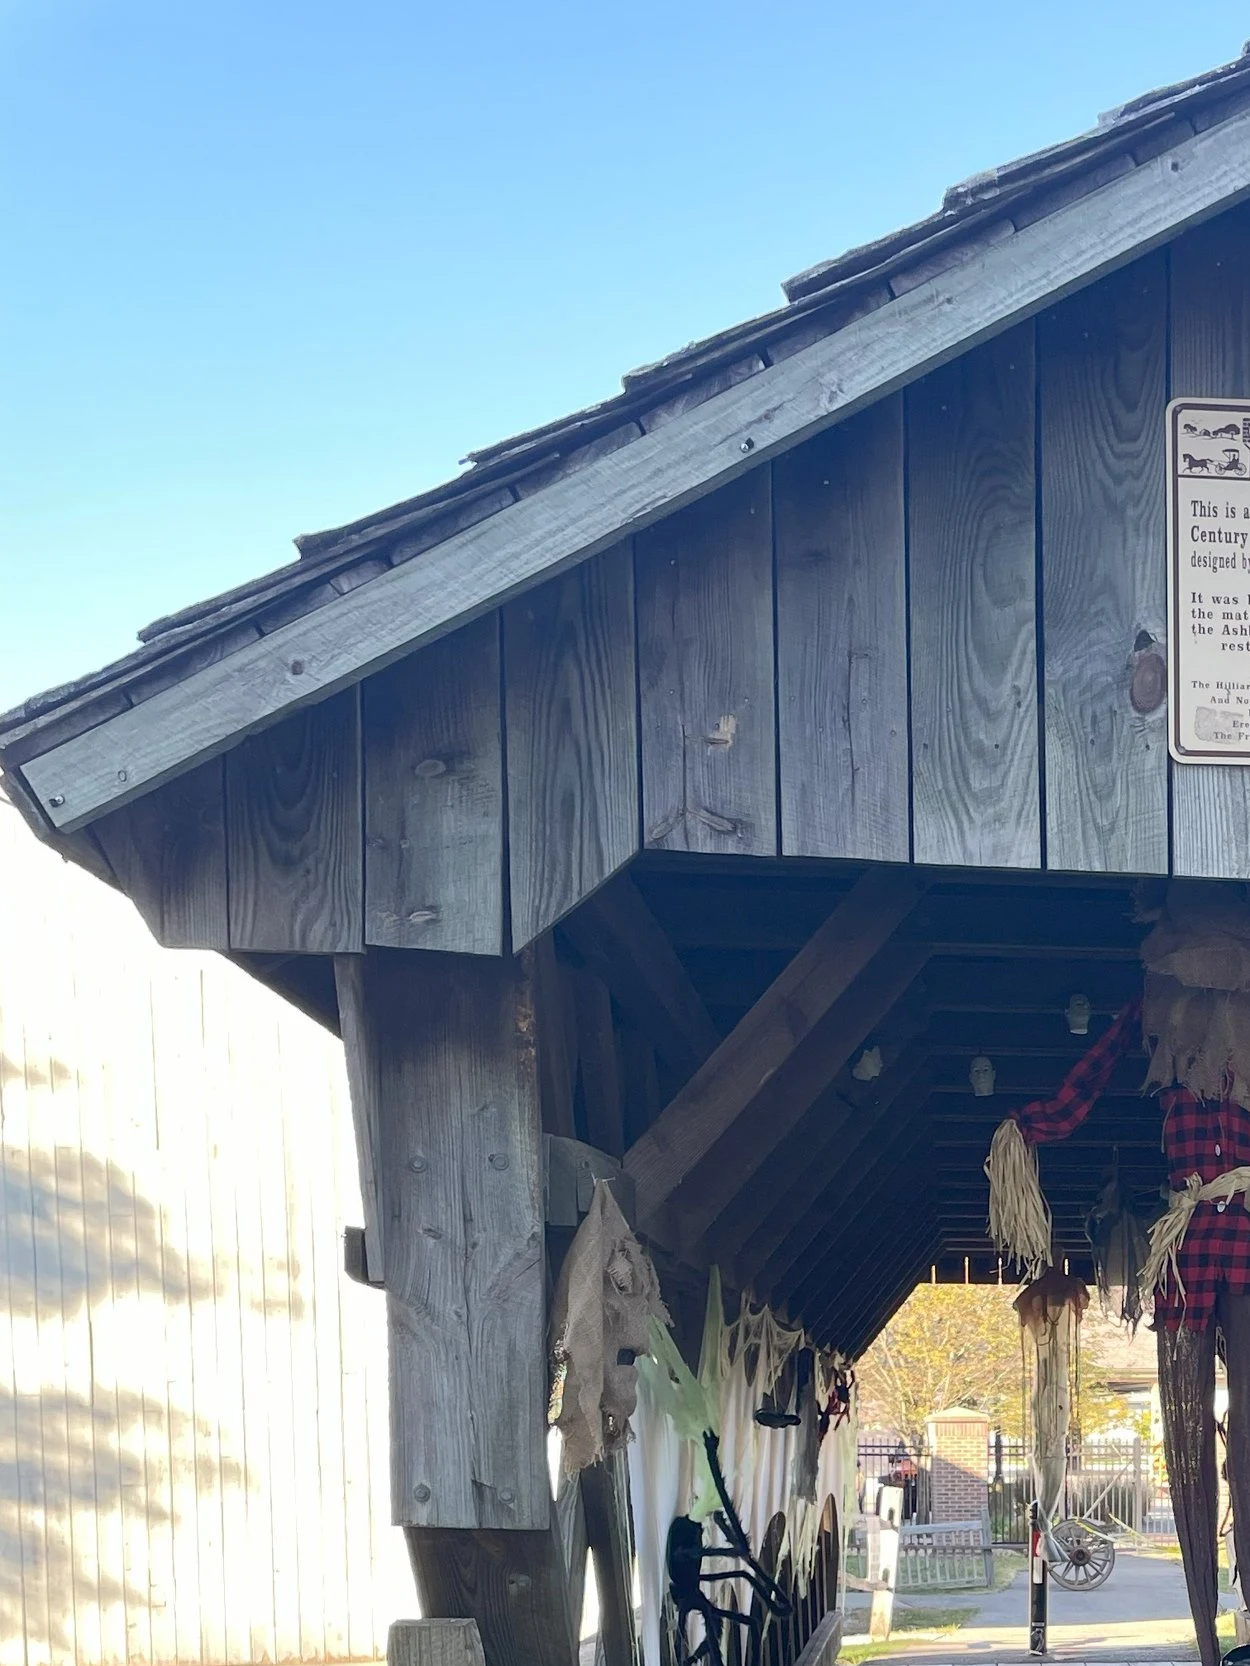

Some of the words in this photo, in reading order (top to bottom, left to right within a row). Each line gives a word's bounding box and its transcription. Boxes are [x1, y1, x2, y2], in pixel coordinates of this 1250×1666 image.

[1191, 500, 1217, 517] This
[1226, 502, 1235, 518] is
[1244, 507, 1250, 519] a
[1191, 525, 1248, 548] Century
[1191, 551, 1236, 573] designed
[1192, 592, 1202, 603] It
[1212, 596, 1238, 604] was
[1192, 608, 1213, 619] the
[1192, 624, 1213, 635] the
[1210, 696, 1230, 704] And
[1213, 732, 1232, 740] The
